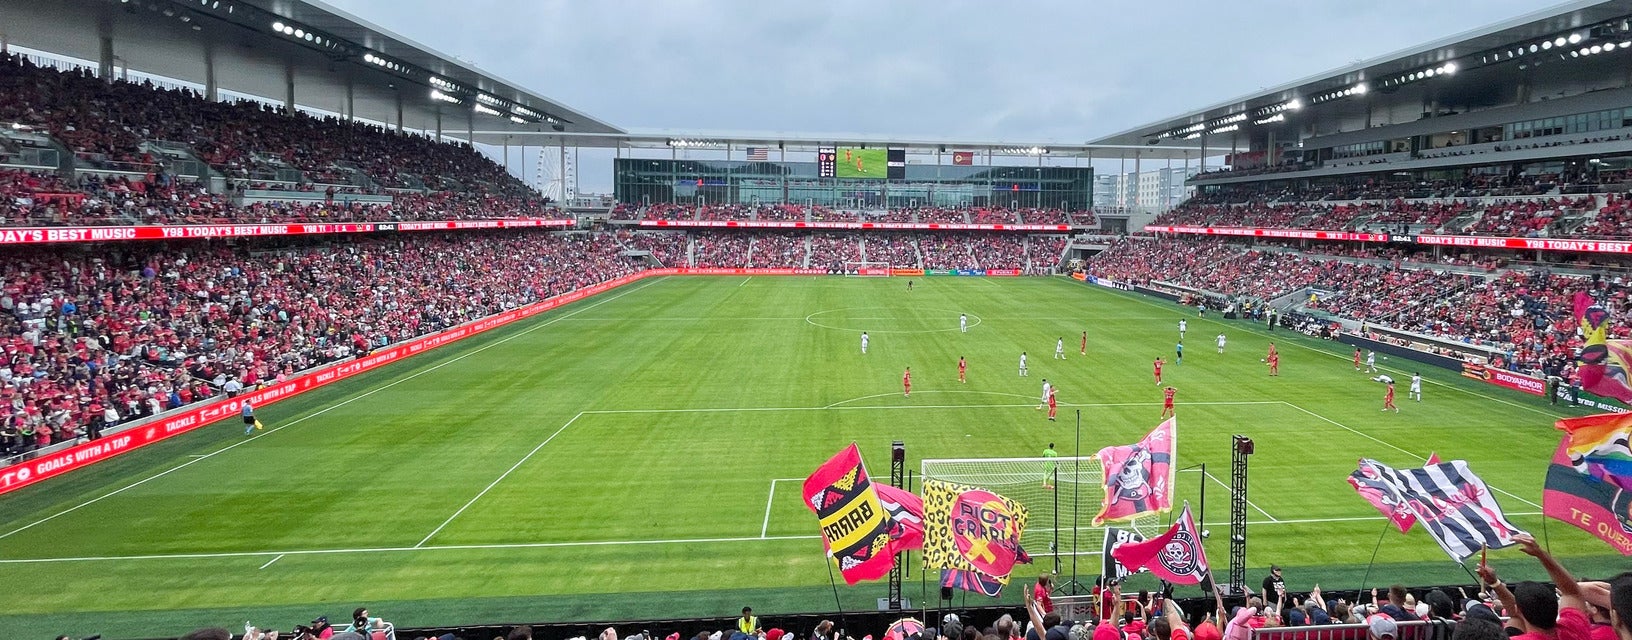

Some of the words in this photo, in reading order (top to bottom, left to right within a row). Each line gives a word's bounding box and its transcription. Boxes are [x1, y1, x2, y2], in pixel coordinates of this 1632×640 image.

[48, 229, 88, 240] BEST
[92, 228, 136, 239] MUSIC
[162, 228, 183, 237] Y98
[187, 227, 231, 236] TODAY'S
[234, 226, 259, 235] BEST
[260, 225, 288, 234] MUSIC
[1420, 236, 1453, 245] TODAY'S
[1454, 237, 1475, 246] BEST
[1478, 238, 1506, 247] MUSIC
[1526, 240, 1544, 249] Y98
[1547, 241, 1595, 250] TODAY'S
[1598, 242, 1631, 252] BEST
[316, 370, 335, 383] TACKLE
[1496, 373, 1543, 390] BODYARMOR
[263, 389, 280, 400] WITH
[279, 388, 285, 396] A
[284, 383, 296, 395] TAP
[166, 415, 196, 433] TACKLE
[37, 455, 73, 474] GOALS
[75, 445, 101, 462] WITH
[103, 443, 112, 453] A
[112, 435, 131, 449] TAP
[960, 502, 1011, 528] RIOT
[1570, 507, 1592, 526] TE
[954, 517, 1017, 551] GRRRLS
